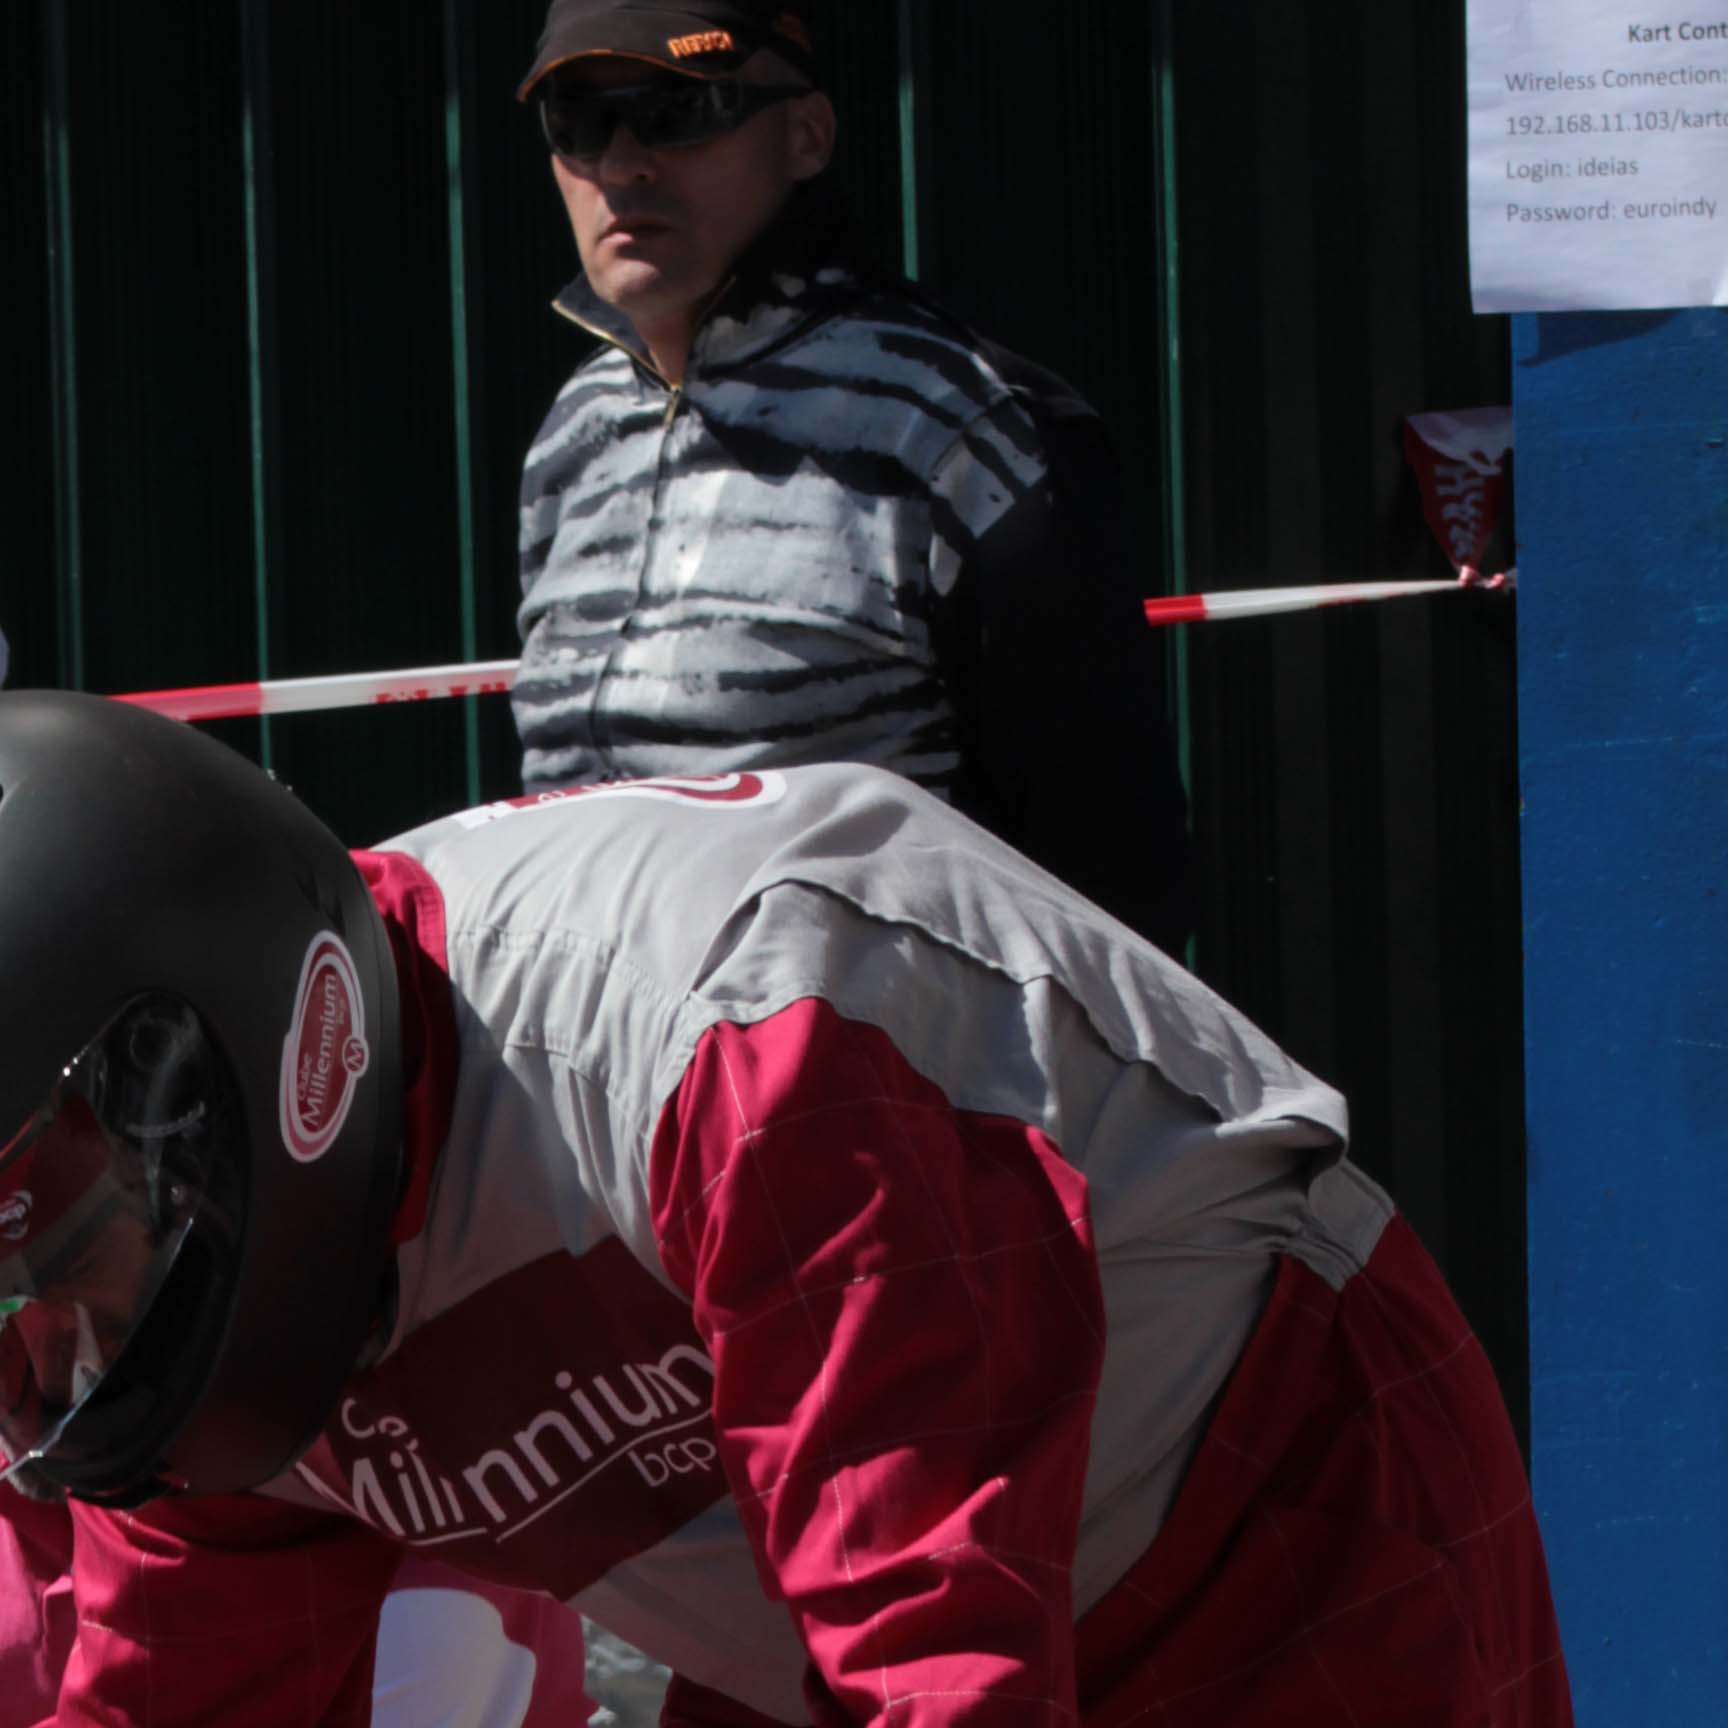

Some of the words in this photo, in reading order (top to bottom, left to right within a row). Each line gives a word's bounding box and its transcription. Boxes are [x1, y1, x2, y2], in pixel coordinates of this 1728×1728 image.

[1628, 25, 1671, 43] Kart
[1505, 72, 1595, 91] Wireless
[1602, 65, 1727, 88] Connection:
[1506, 160, 1570, 183] Login:
[1577, 157, 1639, 178] ideias
[1507, 202, 1616, 222] Password:
[1623, 196, 1717, 219] euroindy
[627, 1437, 717, 1488] bcp
